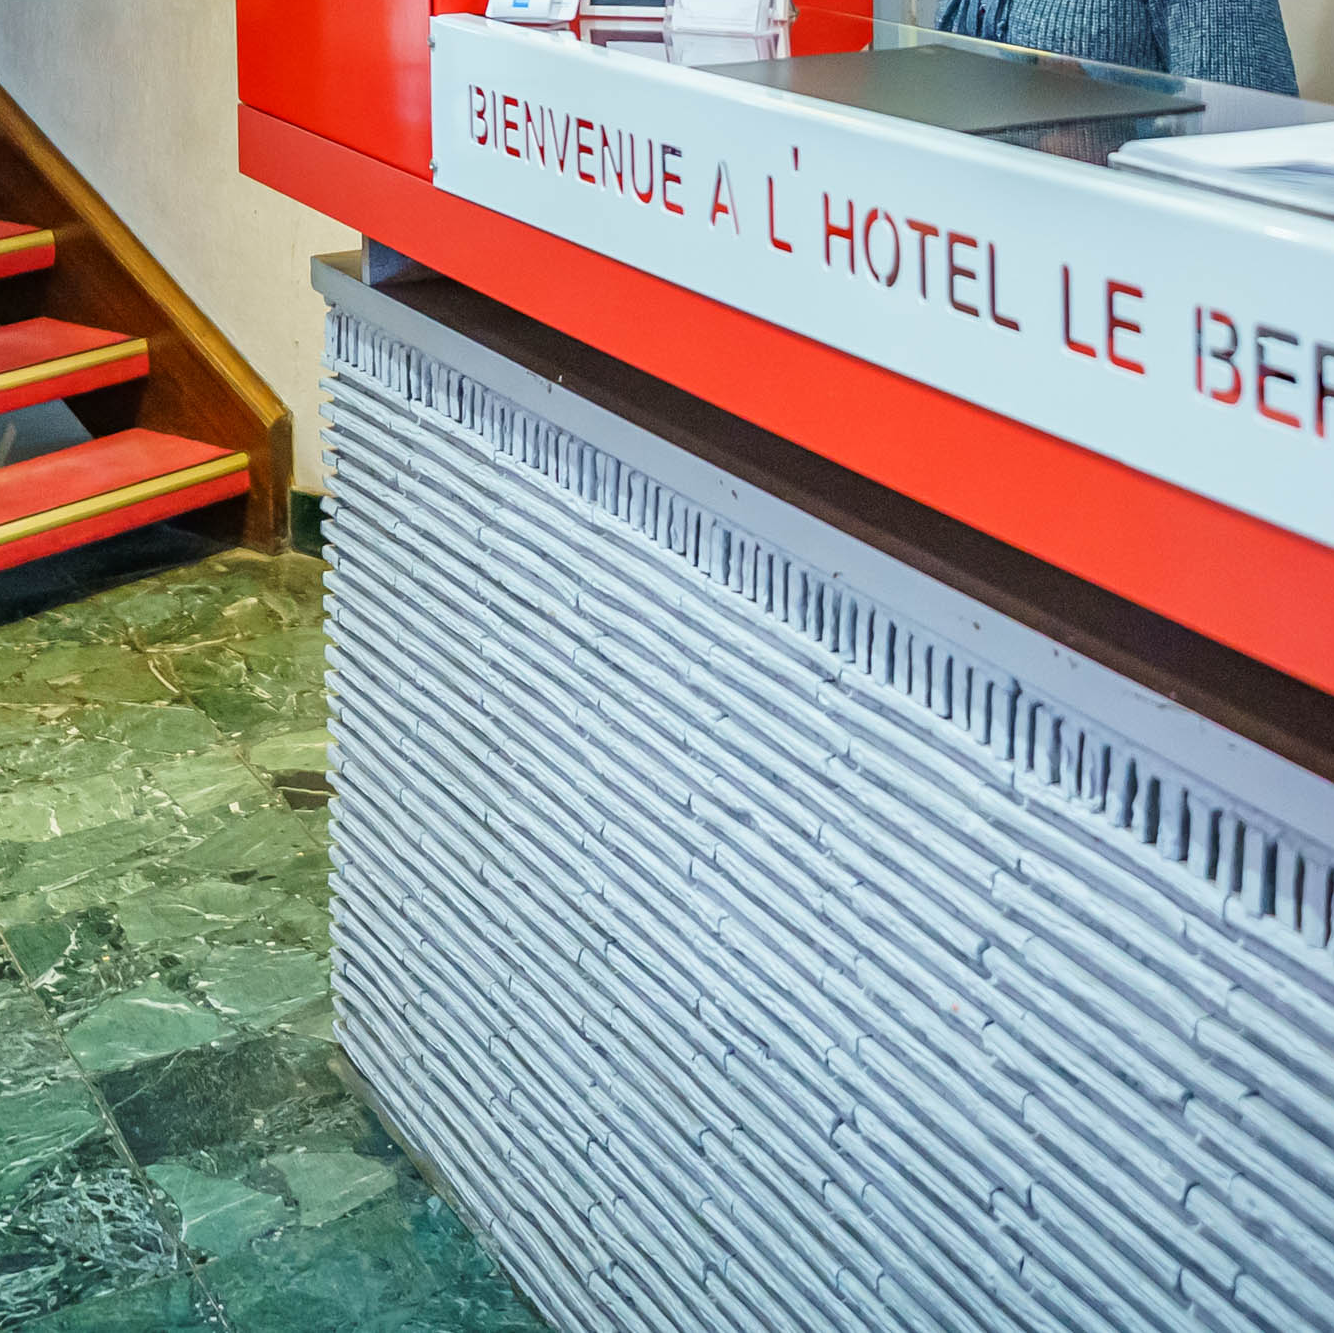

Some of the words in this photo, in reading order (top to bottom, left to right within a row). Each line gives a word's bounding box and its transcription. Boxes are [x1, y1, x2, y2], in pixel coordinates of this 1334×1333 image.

[469, 84, 685, 216] BIENVENUE
[711, 161, 740, 235] A
[823, 191, 1021, 332] HOTEL
[1061, 263, 1146, 376] LE
